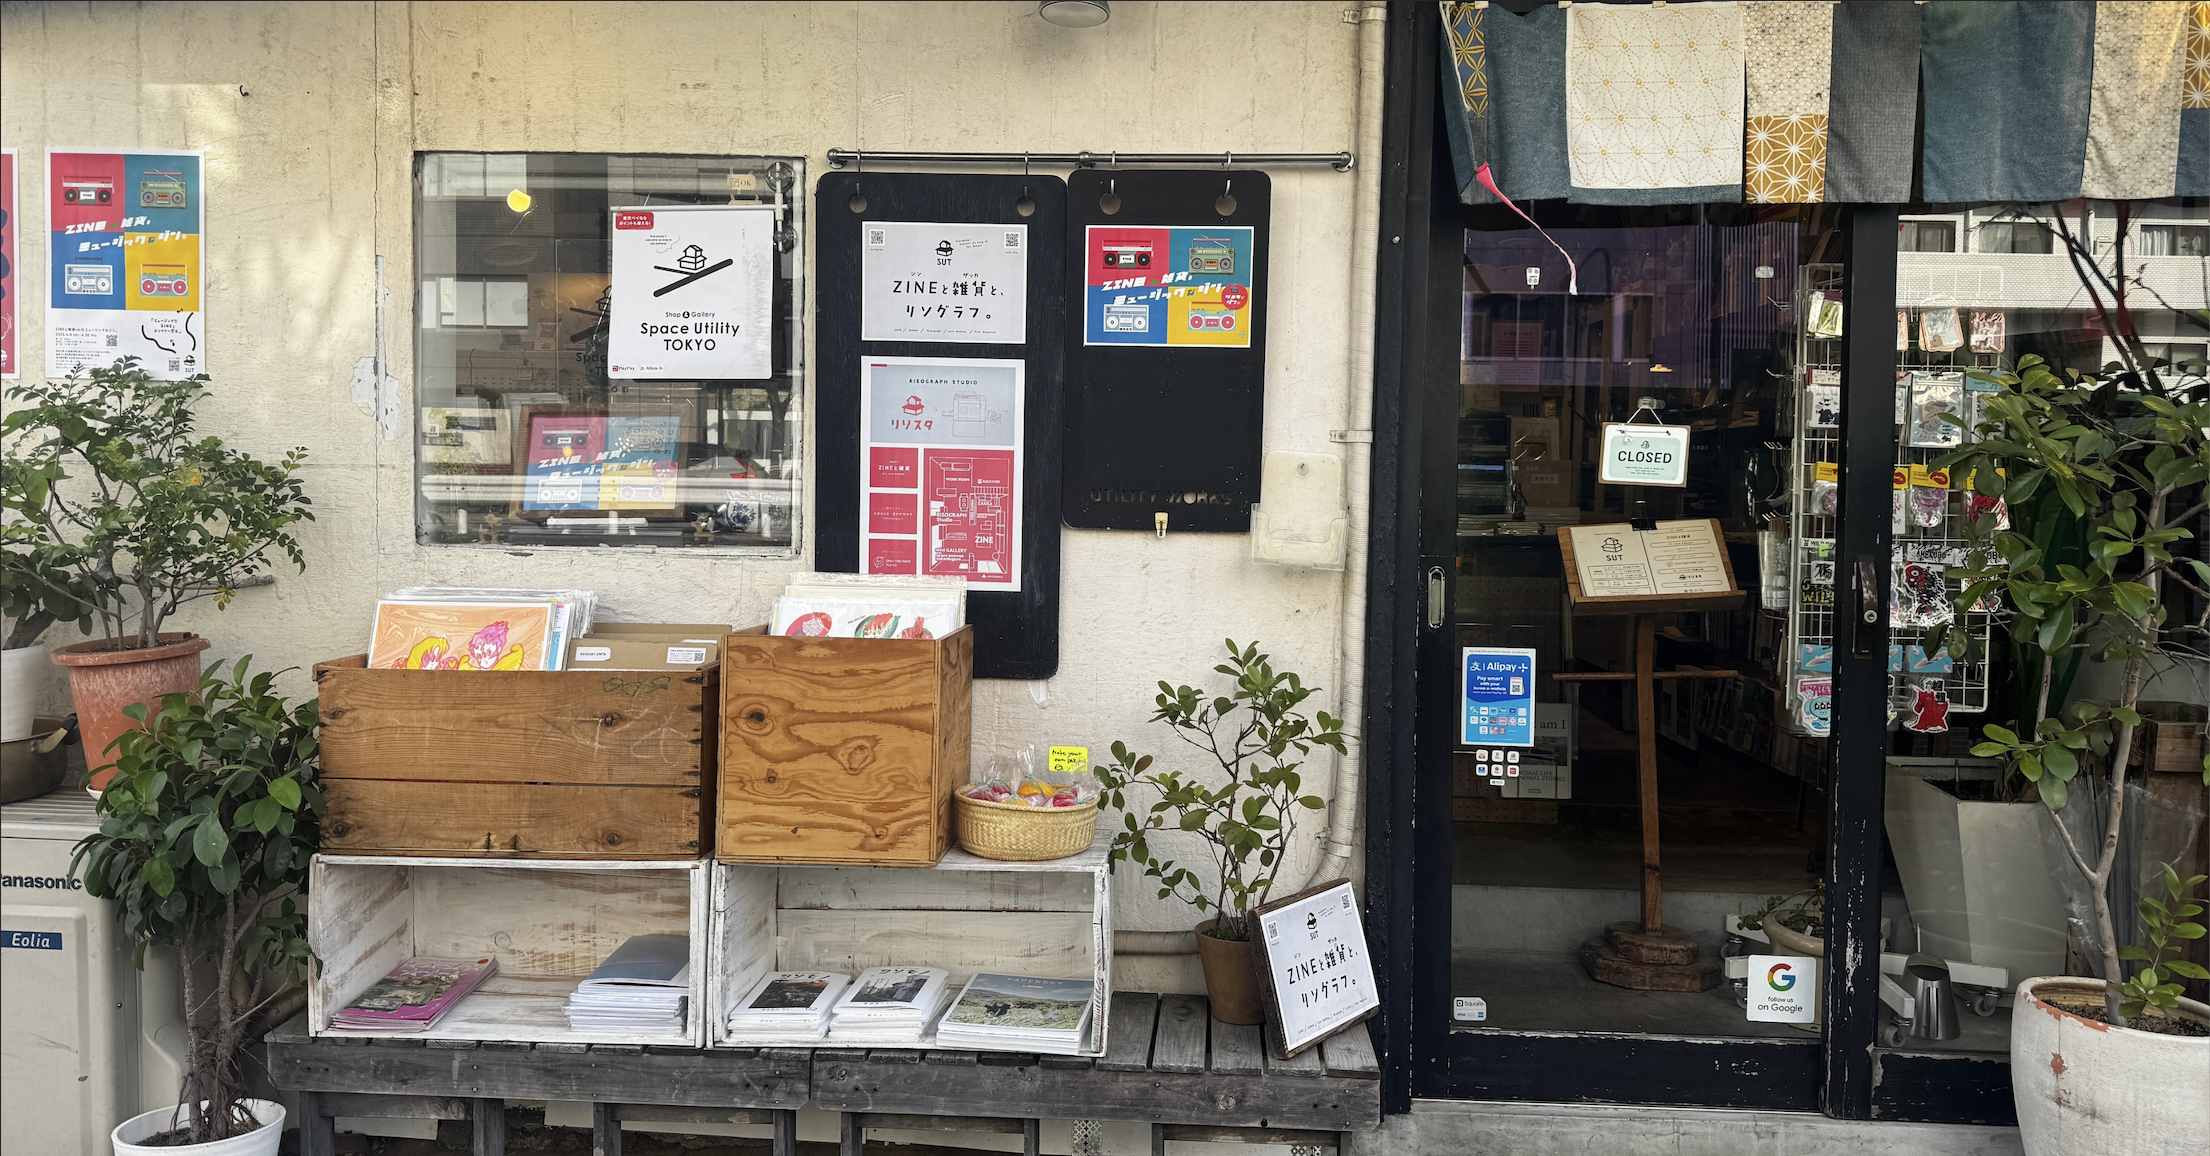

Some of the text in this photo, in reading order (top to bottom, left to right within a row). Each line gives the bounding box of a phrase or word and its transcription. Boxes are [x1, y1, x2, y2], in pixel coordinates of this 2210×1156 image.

[936, 258, 952, 266] SUT
[893, 280, 1004, 297] ZINEと雑貨と、
[665, 311, 681, 319] Shop
[906, 304, 992, 320] リソグラフ。
[640, 322, 740, 337] Space Utility
[663, 339, 716, 351] TOKYO
[891, 419, 934, 431] リソスタ
[1618, 450, 1672, 464] CLOSED
[1090, 489, 1233, 505] UTILITY WORKS
[975, 536, 994, 544] ZINE
[1605, 554, 1623, 562] SUT
[1540, 721, 1558, 730] am
[1, 874, 82, 890] anasonic
[12, 932, 50, 948] Eolia
[1309, 930, 1319, 940] SUT
[1287, 943, 1359, 985] ZINEと雑貨と、
[1007, 977, 1064, 985] PAPERSKY
[1301, 974, 1356, 1008] リソグラフ。
[1771, 1003, 1803, 1014] Google
